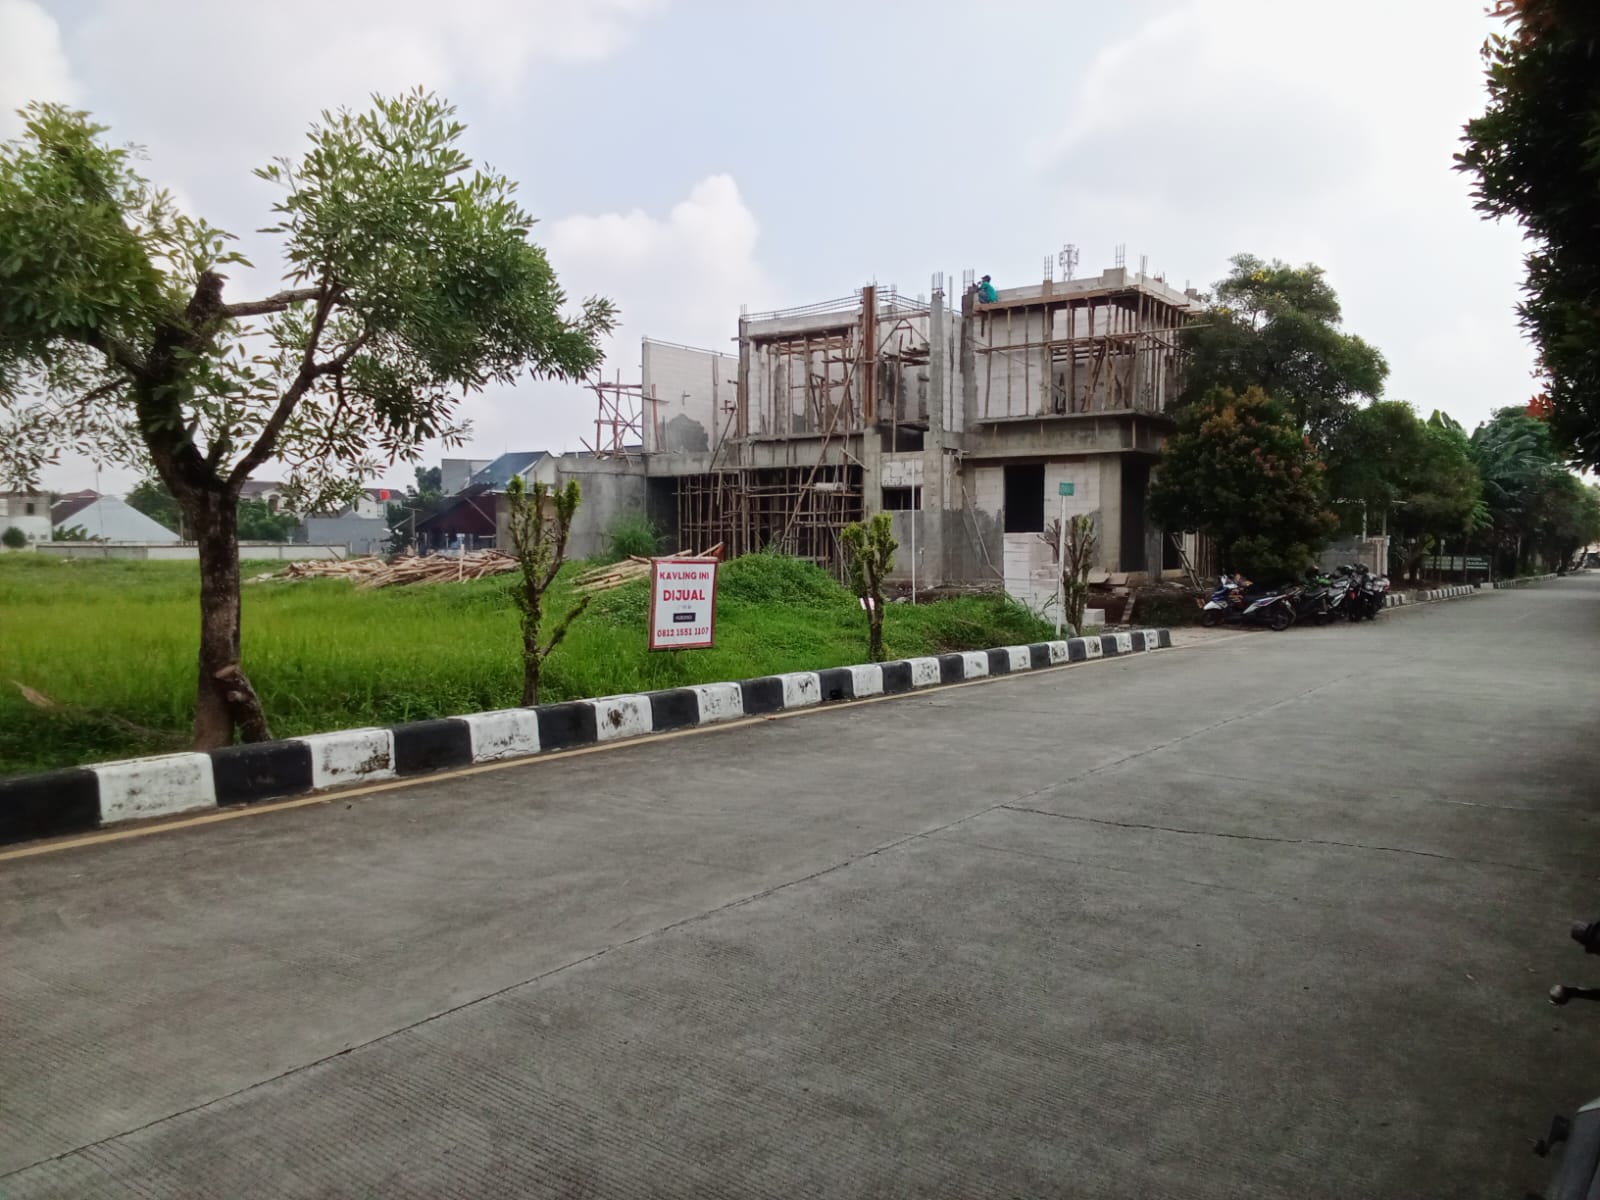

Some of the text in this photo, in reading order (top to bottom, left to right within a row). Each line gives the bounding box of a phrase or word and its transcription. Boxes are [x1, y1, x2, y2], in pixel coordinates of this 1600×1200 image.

[660, 571, 709, 580] KAVLING INI
[663, 589, 705, 601] DIJUAL
[657, 629, 675, 637] 0812
[694, 627, 709, 635] 1107
